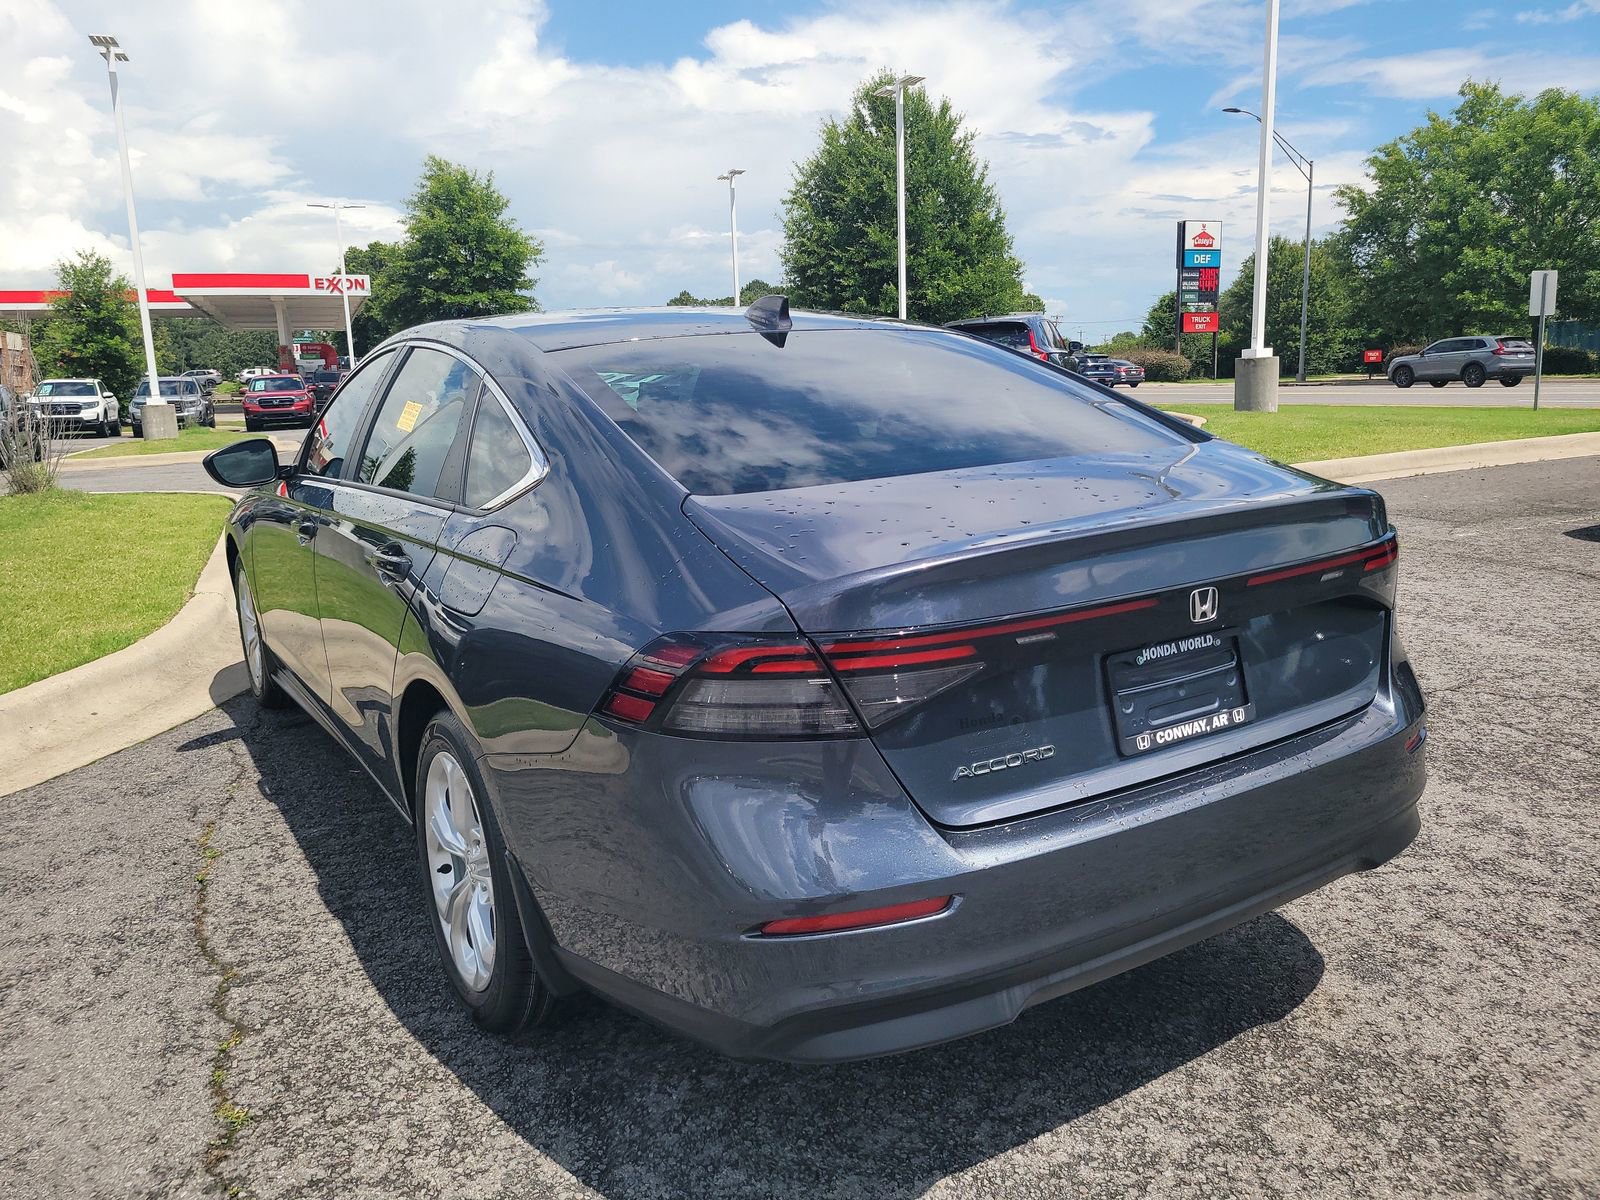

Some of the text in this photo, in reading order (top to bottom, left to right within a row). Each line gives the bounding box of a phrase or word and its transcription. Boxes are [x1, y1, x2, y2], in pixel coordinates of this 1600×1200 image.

[1194, 254, 1211, 264] DEF
[314, 276, 365, 294] EXXON
[1142, 634, 1213, 661] HONDA WORLD
[1155, 713, 1229, 744] CONWAY, AR
[952, 744, 1057, 782] ACCORD
